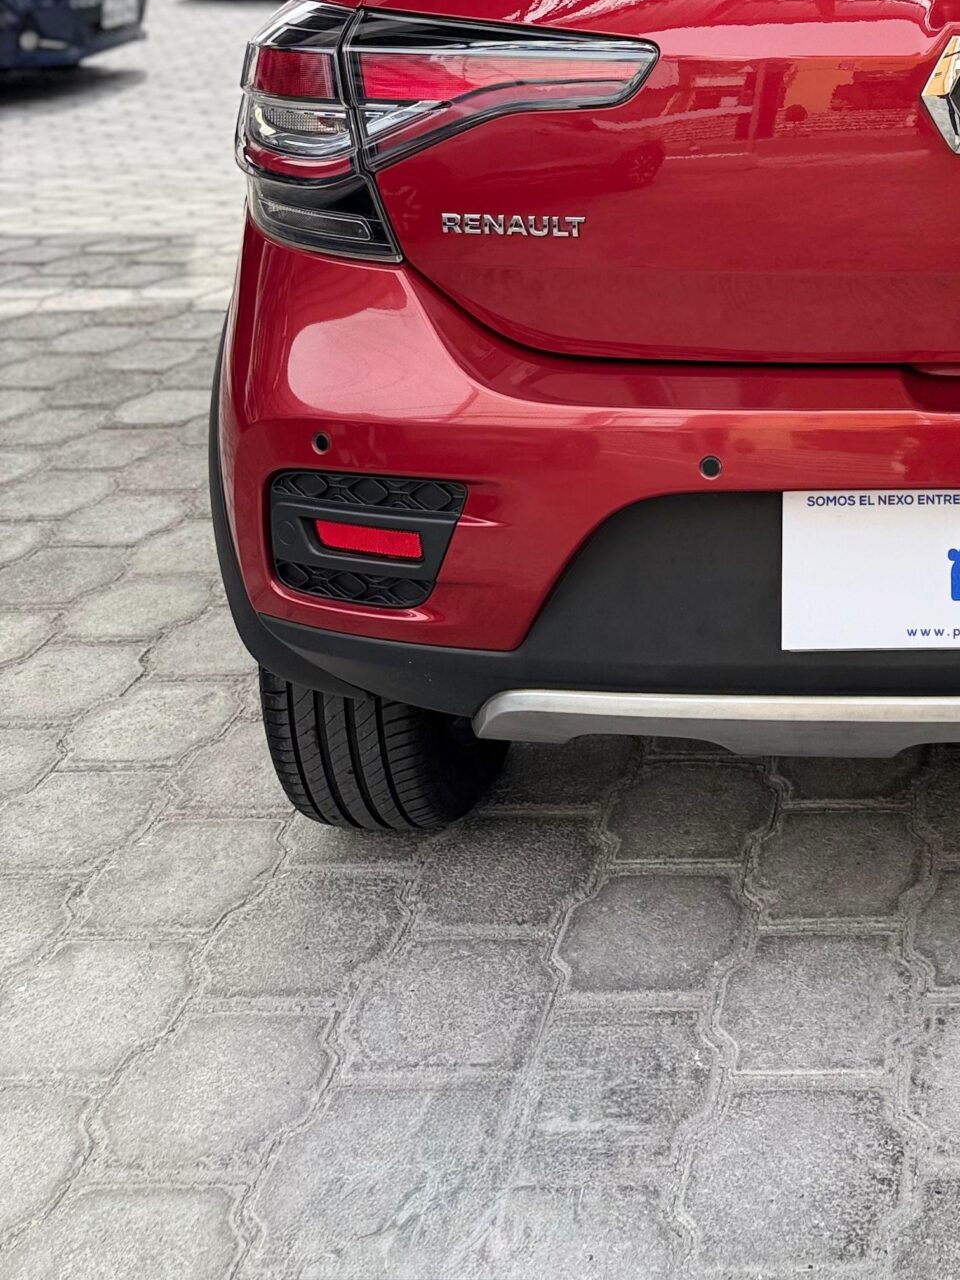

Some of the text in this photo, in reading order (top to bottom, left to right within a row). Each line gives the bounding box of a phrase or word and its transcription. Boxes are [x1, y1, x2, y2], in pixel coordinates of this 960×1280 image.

[441, 212, 586, 238] RENAULT
[806, 494, 856, 507] SOMOS
[858, 494, 876, 506] EL
[877, 494, 915, 506] NEXO
[917, 493, 960, 506] ENTRE
